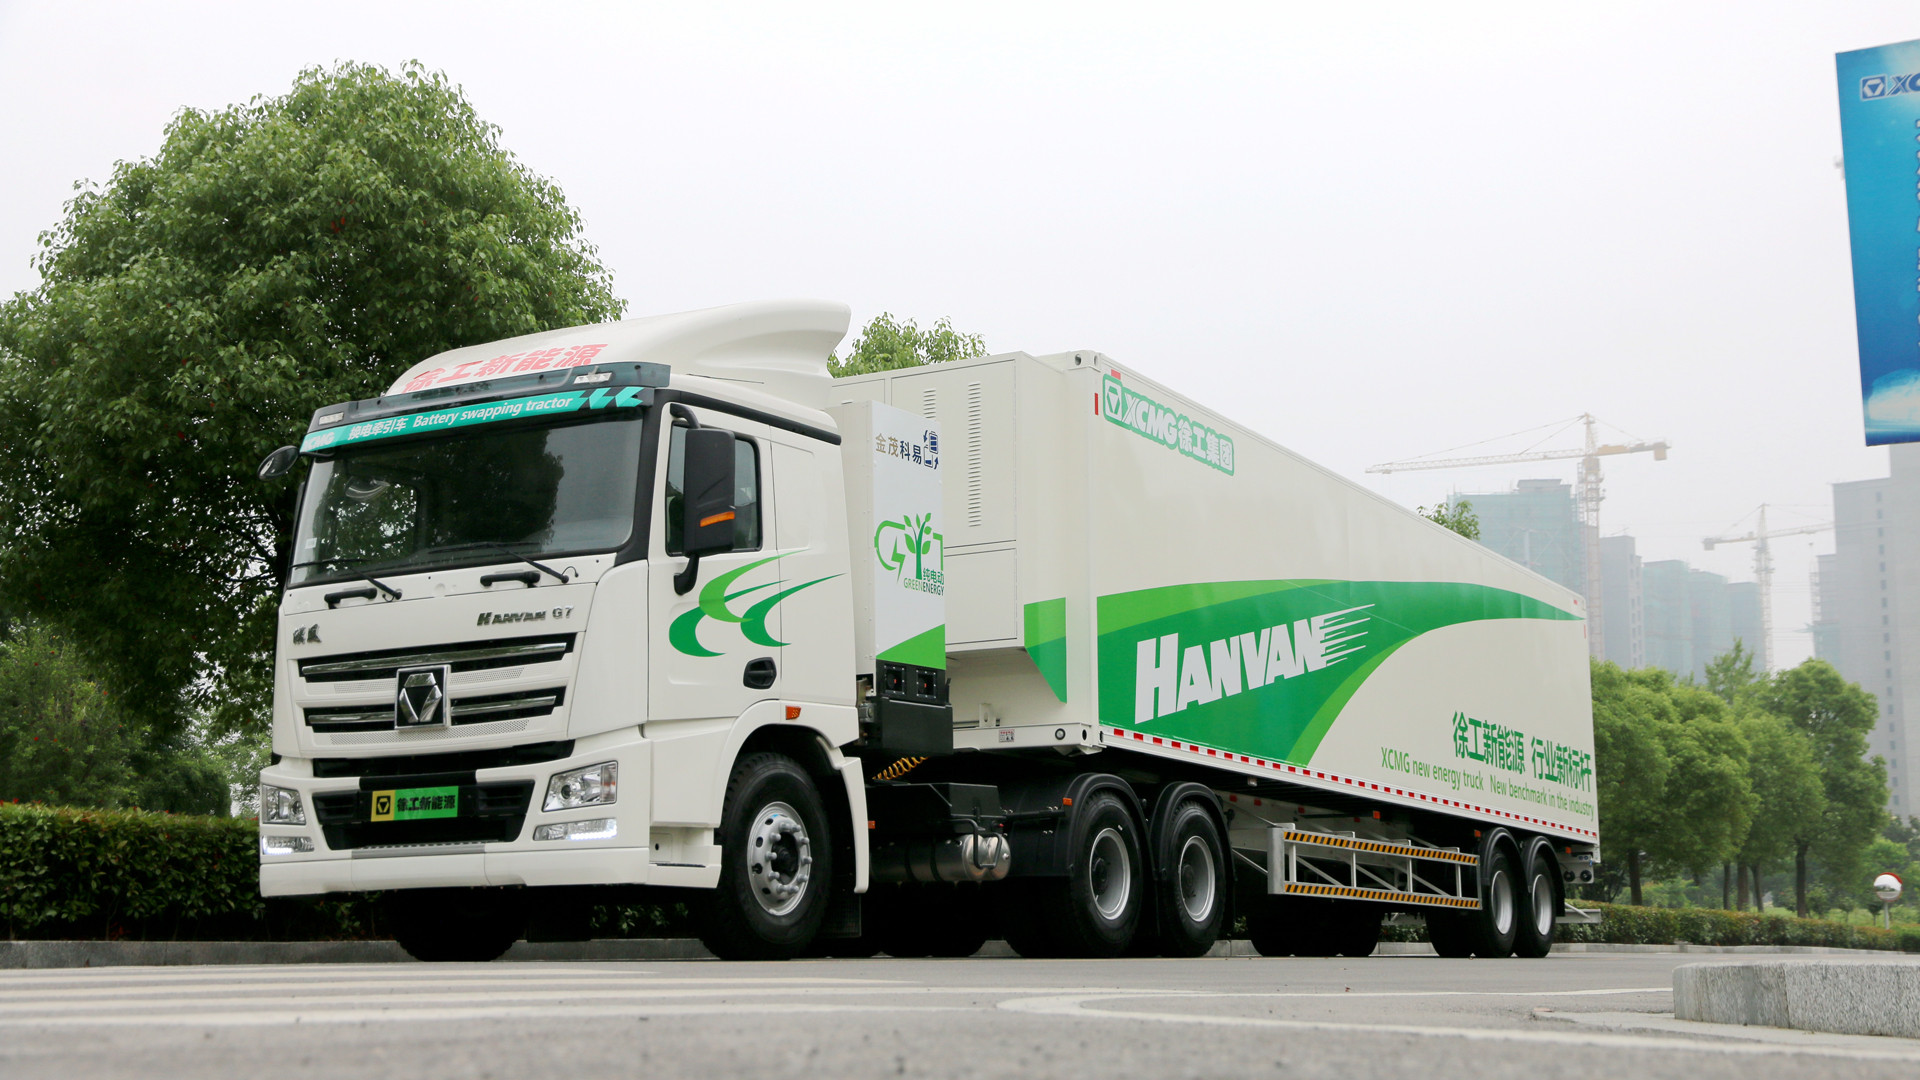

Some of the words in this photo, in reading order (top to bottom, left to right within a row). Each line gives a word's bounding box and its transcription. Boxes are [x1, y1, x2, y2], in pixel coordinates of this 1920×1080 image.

[402, 344, 608, 393] 徐工新能源
[348, 418, 408, 440] 换电牵引车
[413, 410, 459, 428] Battery
[461, 403, 523, 423] swapping
[526, 396, 574, 414] tractor
[1122, 392, 1177, 445] XCMG
[1177, 417, 1233, 472] 徐工集团
[875, 433, 922, 465] 金茂科易
[923, 568, 944, 585] 纯电动
[477, 611, 546, 626] HANVAN
[552, 605, 574, 619] G7
[1134, 604, 1375, 725] HANVAN
[1452, 710, 1526, 775] 徐工新能源
[1531, 736, 1592, 792] 行业新标杆
[397, 795, 454, 811] 徐工新能源
[1381, 746, 1410, 774] XCMG
[1413, 760, 1430, 778] new
[1432, 767, 1461, 791] energy
[1463, 771, 1484, 791] truck
[1490, 774, 1507, 796] New
[1509, 778, 1548, 807] benchmark
[1549, 790, 1556, 806] in
[1556, 790, 1567, 811] the
[1569, 795, 1595, 822] industry
